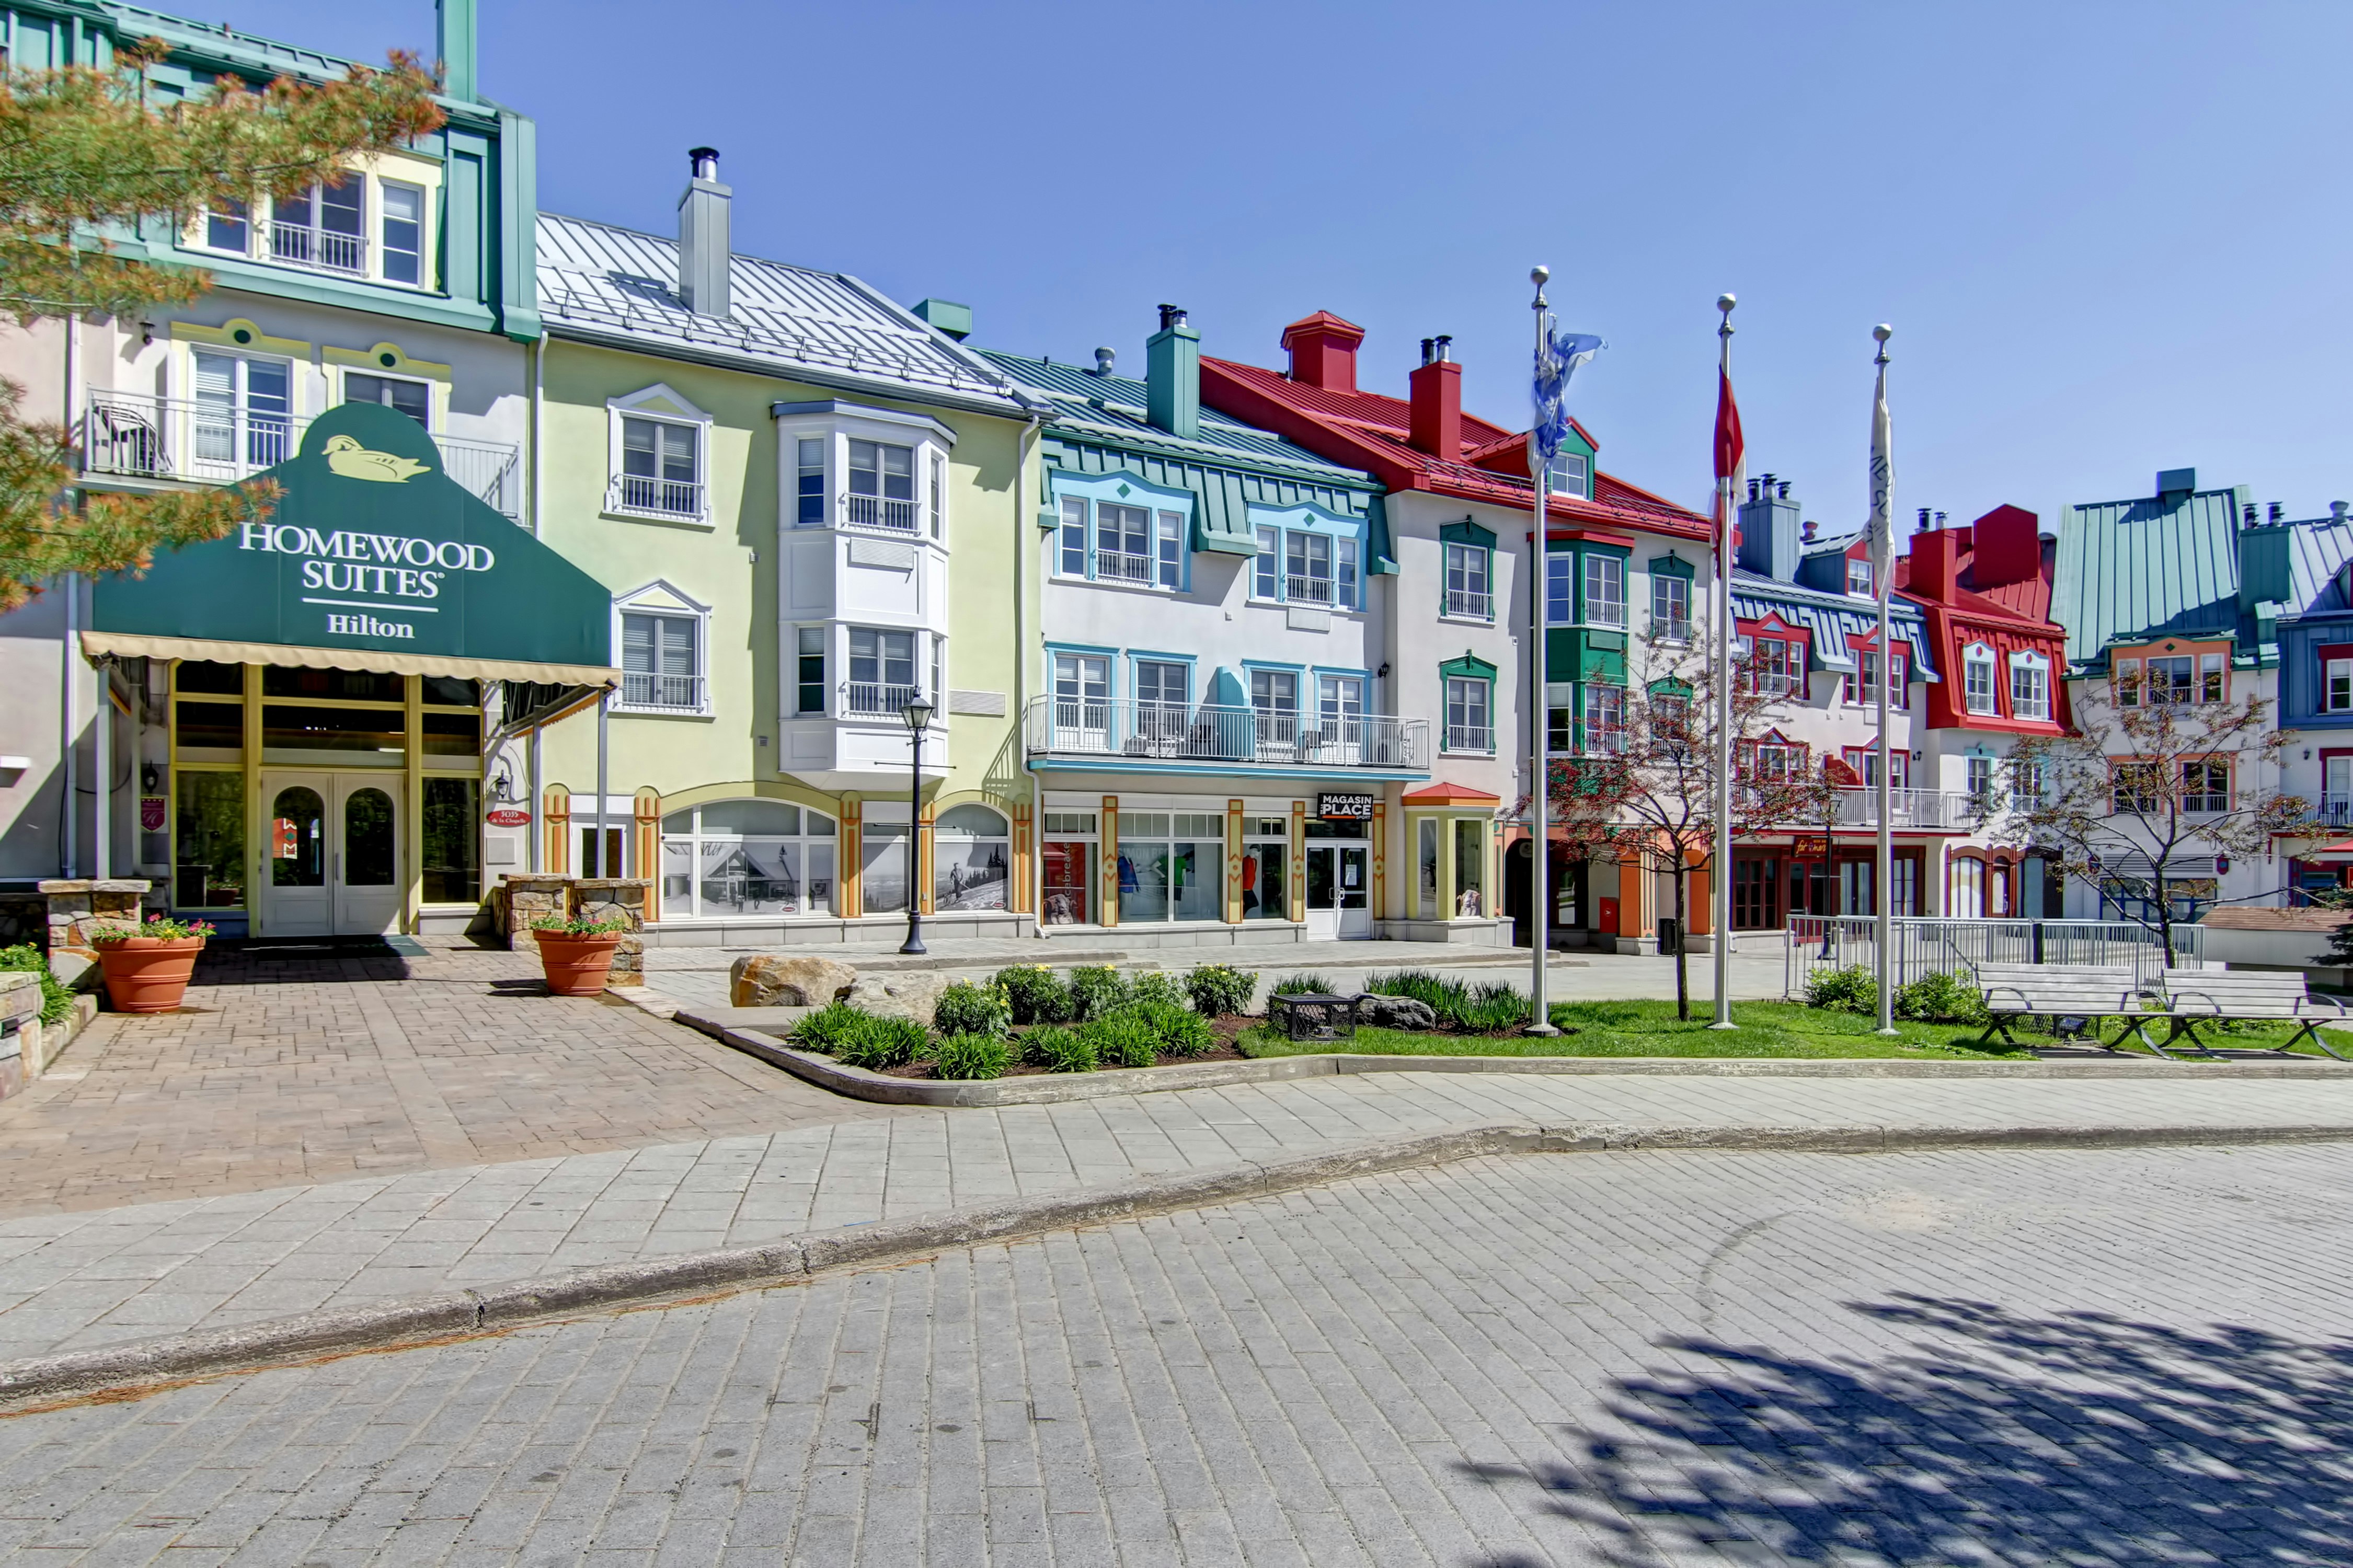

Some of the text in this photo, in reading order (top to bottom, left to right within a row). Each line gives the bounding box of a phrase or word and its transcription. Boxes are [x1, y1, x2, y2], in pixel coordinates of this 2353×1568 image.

[239, 522, 496, 572] HOMEWOOD
[302, 560, 439, 598] SUITES
[327, 614, 415, 639] Hilton
[1323, 795, 1372, 804] MAGASIN
[1323, 804, 1371, 815] PLACE
